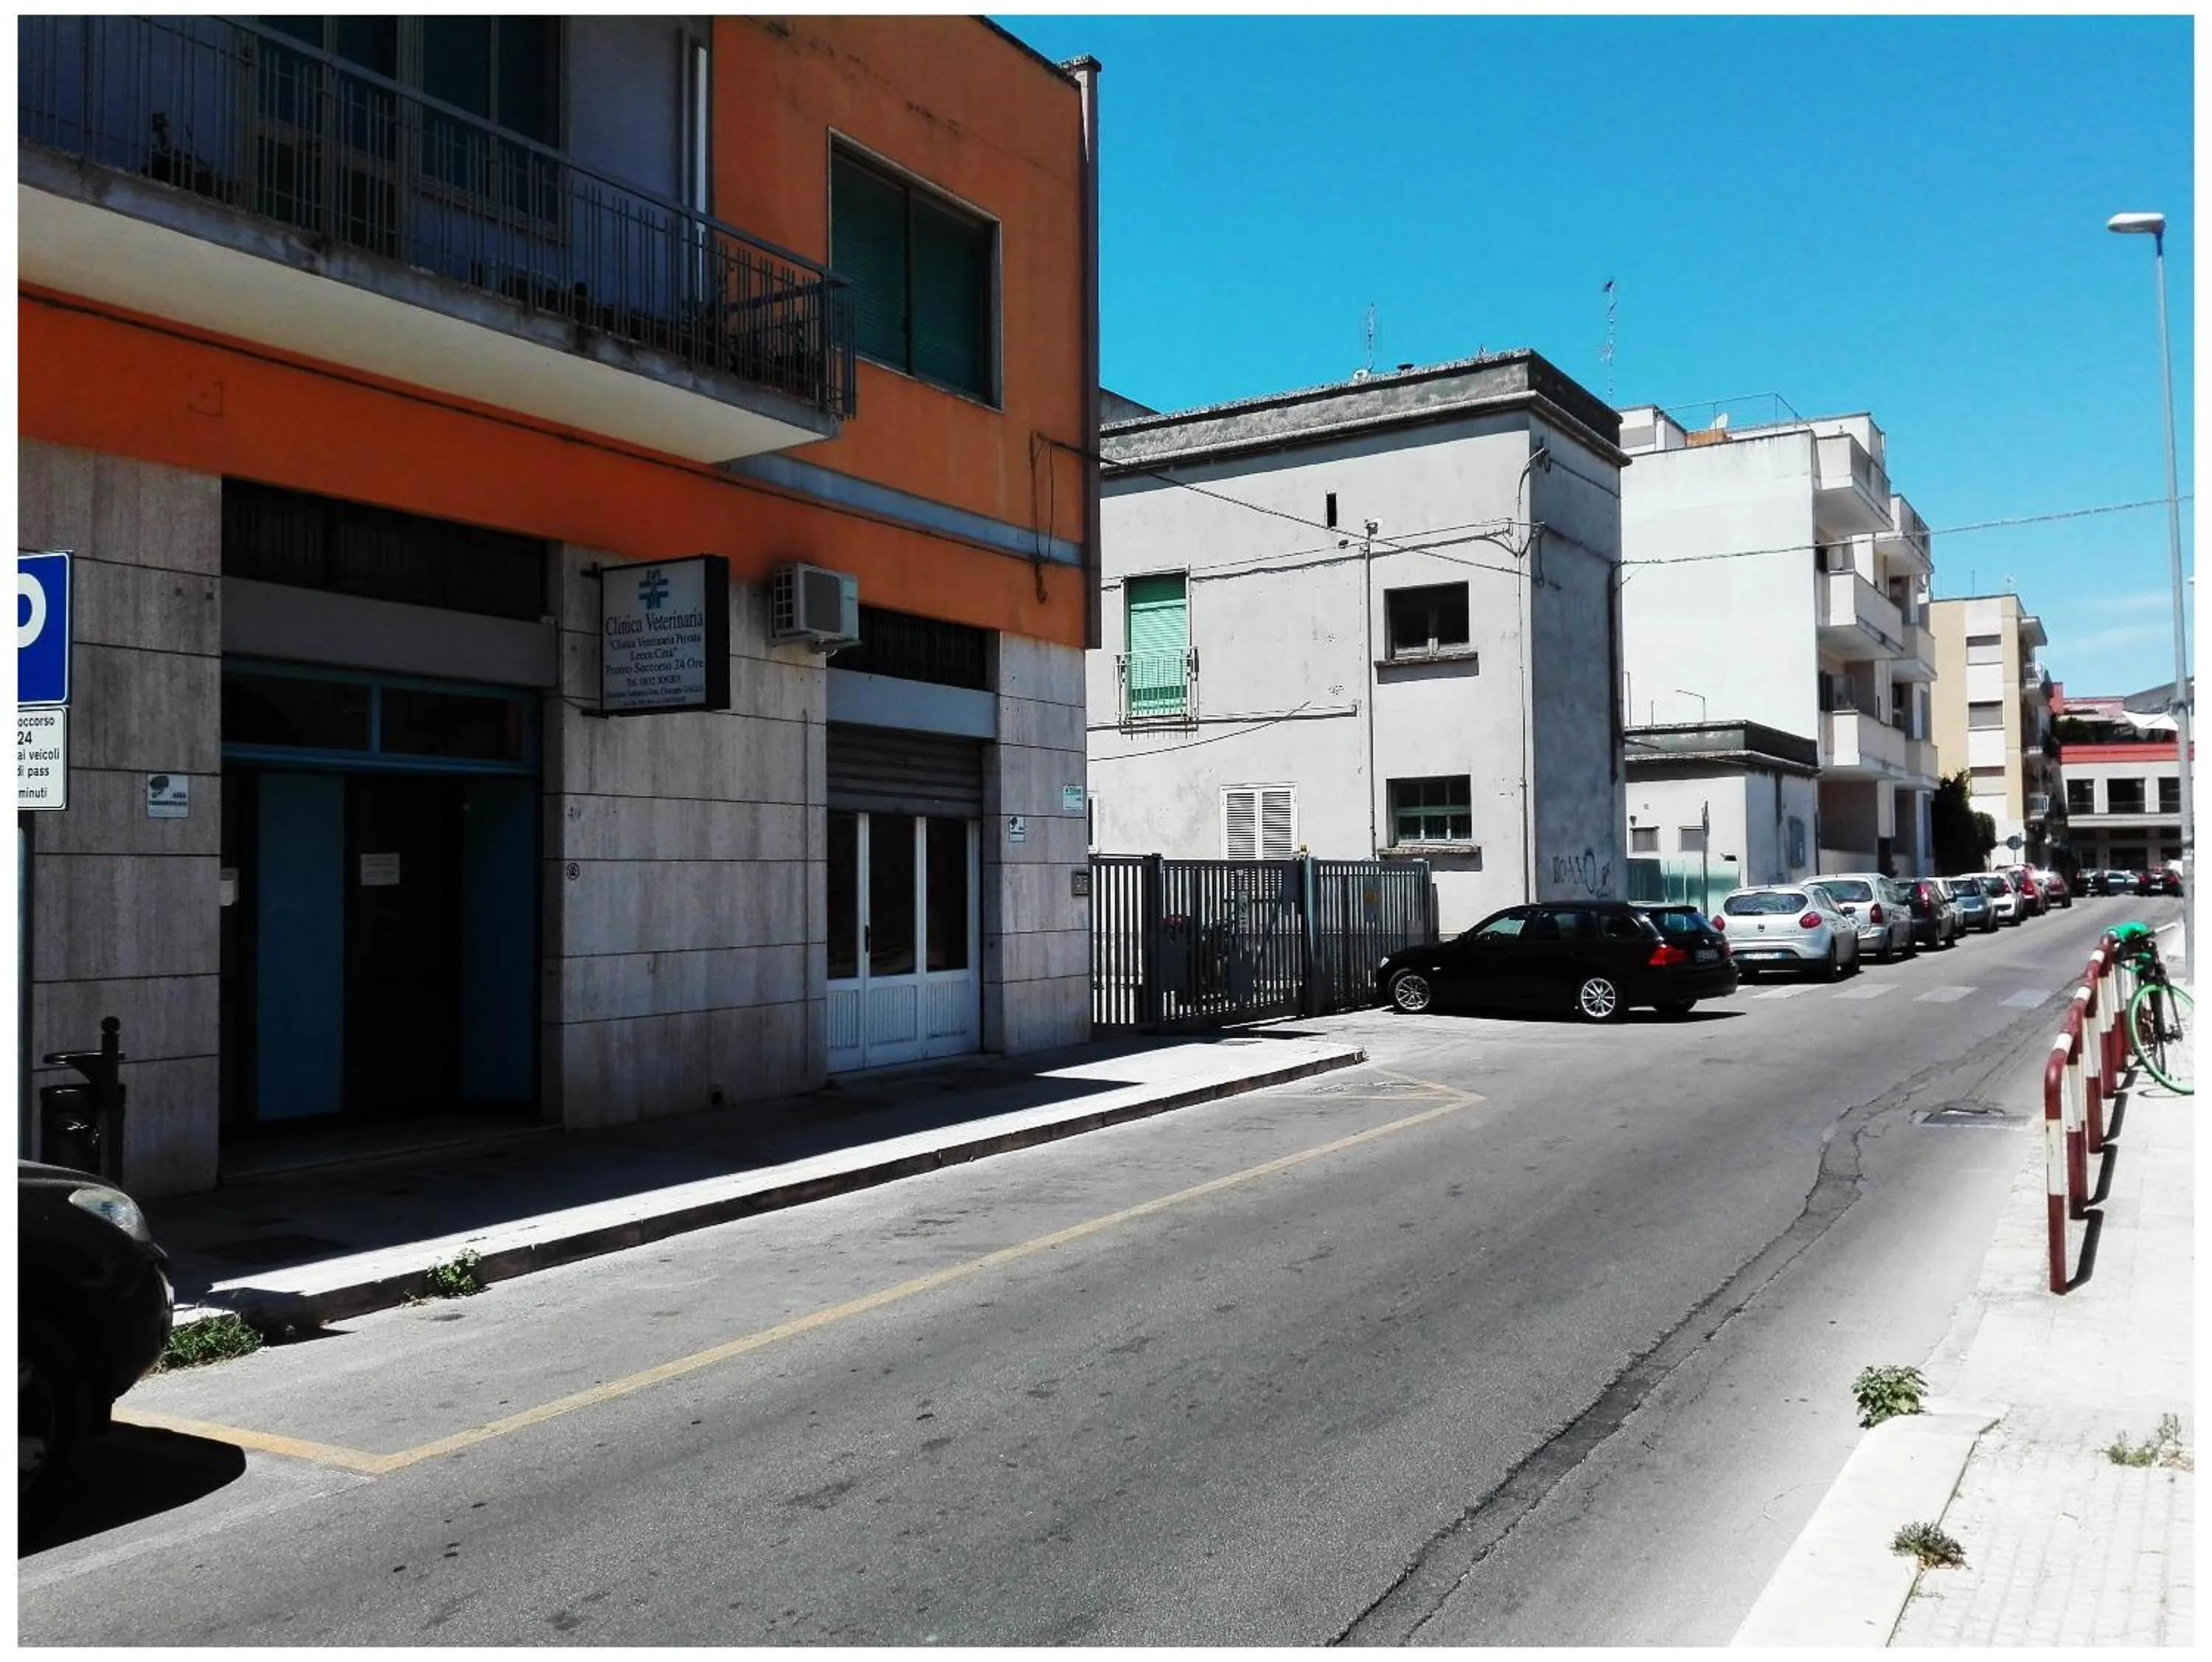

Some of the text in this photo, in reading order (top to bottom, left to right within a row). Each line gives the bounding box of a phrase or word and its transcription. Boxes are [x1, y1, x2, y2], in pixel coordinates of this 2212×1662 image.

[605, 607, 703, 636] Clinica Veterinaria
[674, 659, 685, 670] 24
[686, 658, 704, 669] Ore
[18, 731, 32, 745] 24
[29, 747, 60, 760] veicoli
[27, 767, 49, 779] pass
[18, 787, 48, 798] minuti
